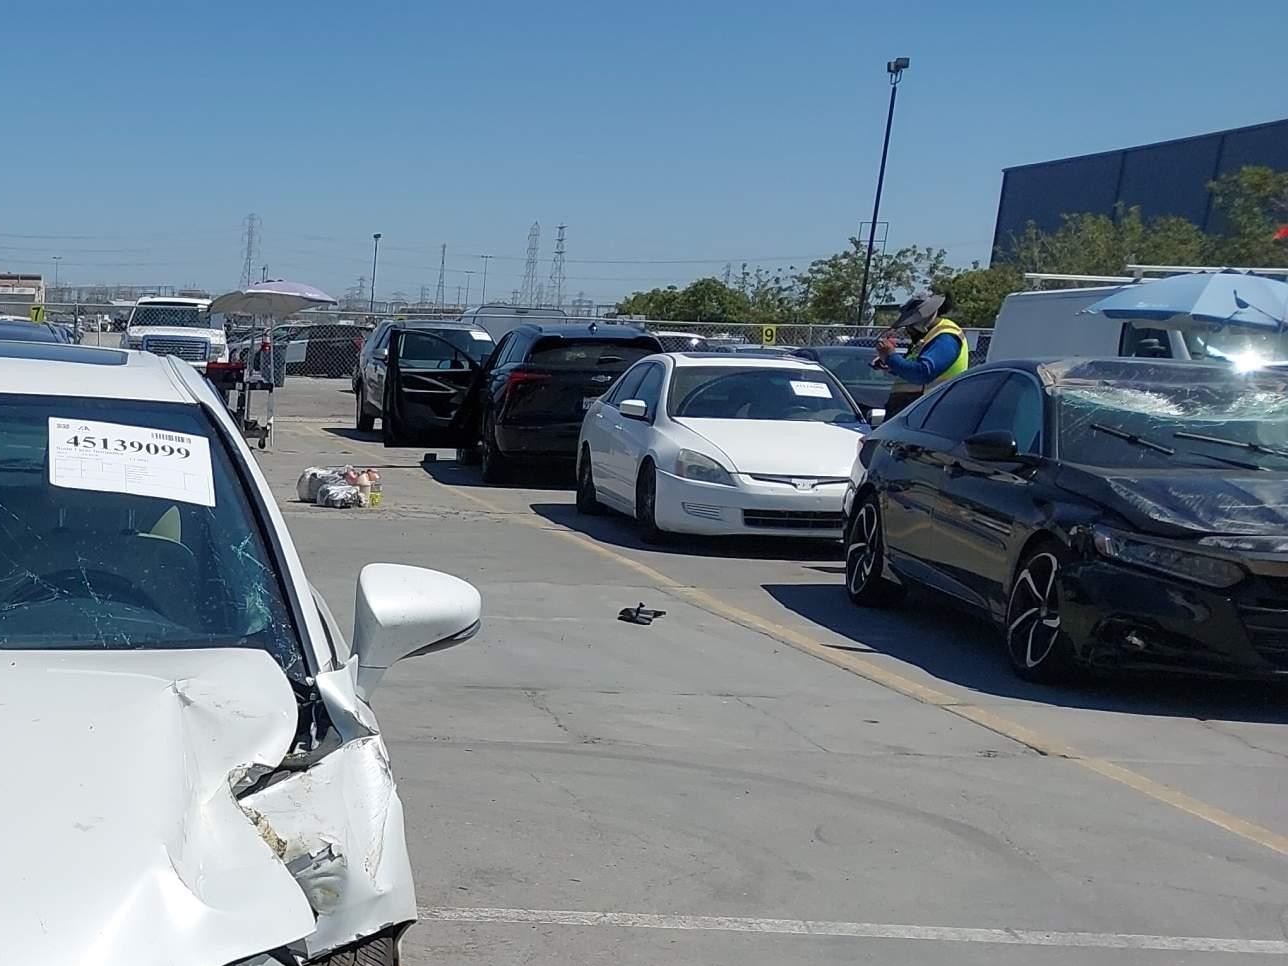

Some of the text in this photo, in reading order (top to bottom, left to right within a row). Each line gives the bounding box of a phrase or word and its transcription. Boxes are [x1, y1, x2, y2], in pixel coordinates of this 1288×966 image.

[32, 307, 41, 321] 7
[764, 328, 774, 342] 9
[66, 435, 191, 459] 45139099
